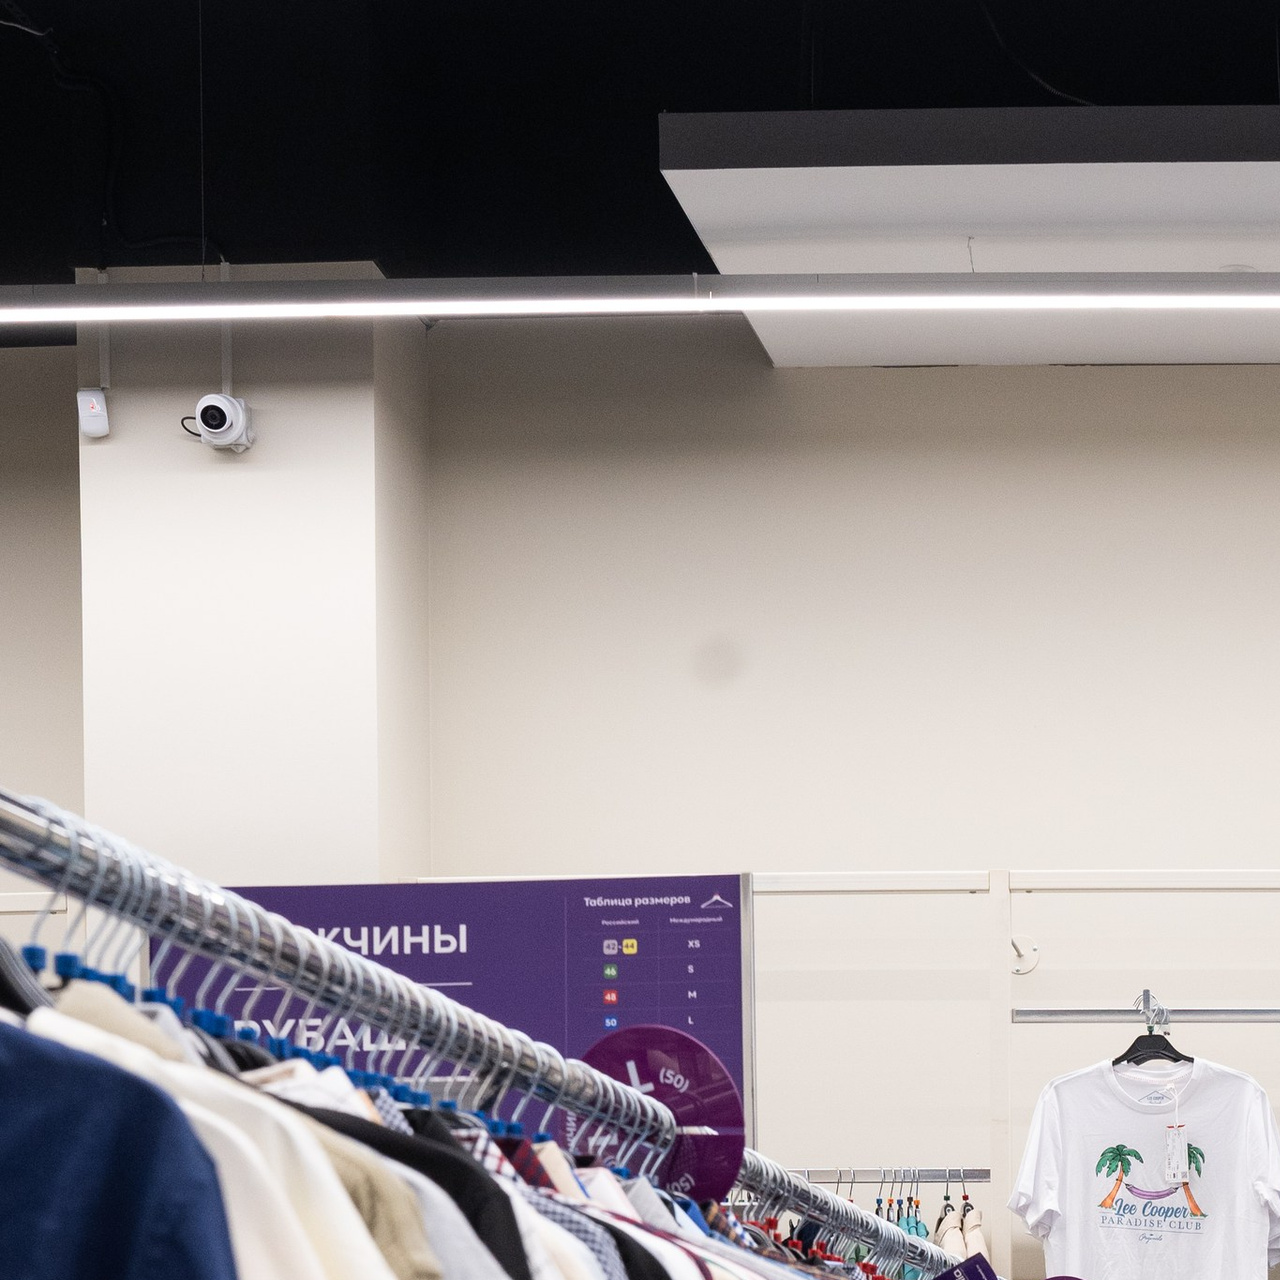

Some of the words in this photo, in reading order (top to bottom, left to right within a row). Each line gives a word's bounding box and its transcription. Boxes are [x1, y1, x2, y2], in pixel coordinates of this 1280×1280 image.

[583, 896, 633, 907] Таблица
[634, 896, 691, 908] размеров
[688, 940, 701, 949] XS
[604, 966, 617, 976] 46
[687, 965, 694, 974] S
[604, 992, 616, 1002] 48
[687, 991, 697, 999] M
[605, 1018, 617, 1027] 50
[687, 1017, 694, 1025] L
[626, 1060, 655, 1093] L
[659, 1067, 690, 1093] (50)
[1113, 1197, 1138, 1218] Lee
[1142, 1200, 1190, 1222] Cooper
[1101, 1215, 1164, 1229] PARADISE
[1168, 1219, 1202, 1231] CLUB
